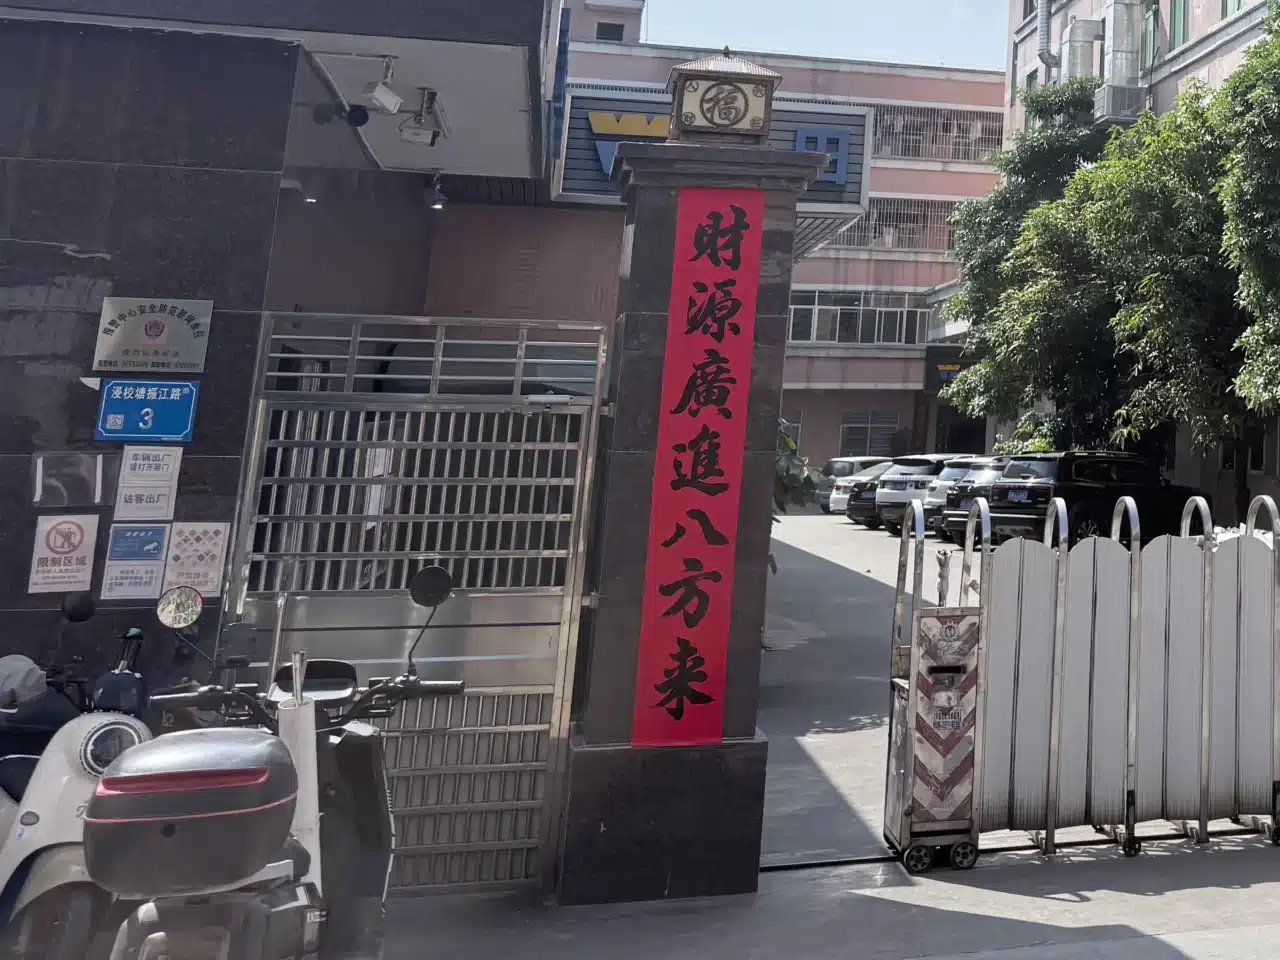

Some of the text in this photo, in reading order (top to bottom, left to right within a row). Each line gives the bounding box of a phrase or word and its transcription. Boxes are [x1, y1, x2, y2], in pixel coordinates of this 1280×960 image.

[110, 386, 182, 401] 浸校塘振江路
[138, 407, 155, 430] 3
